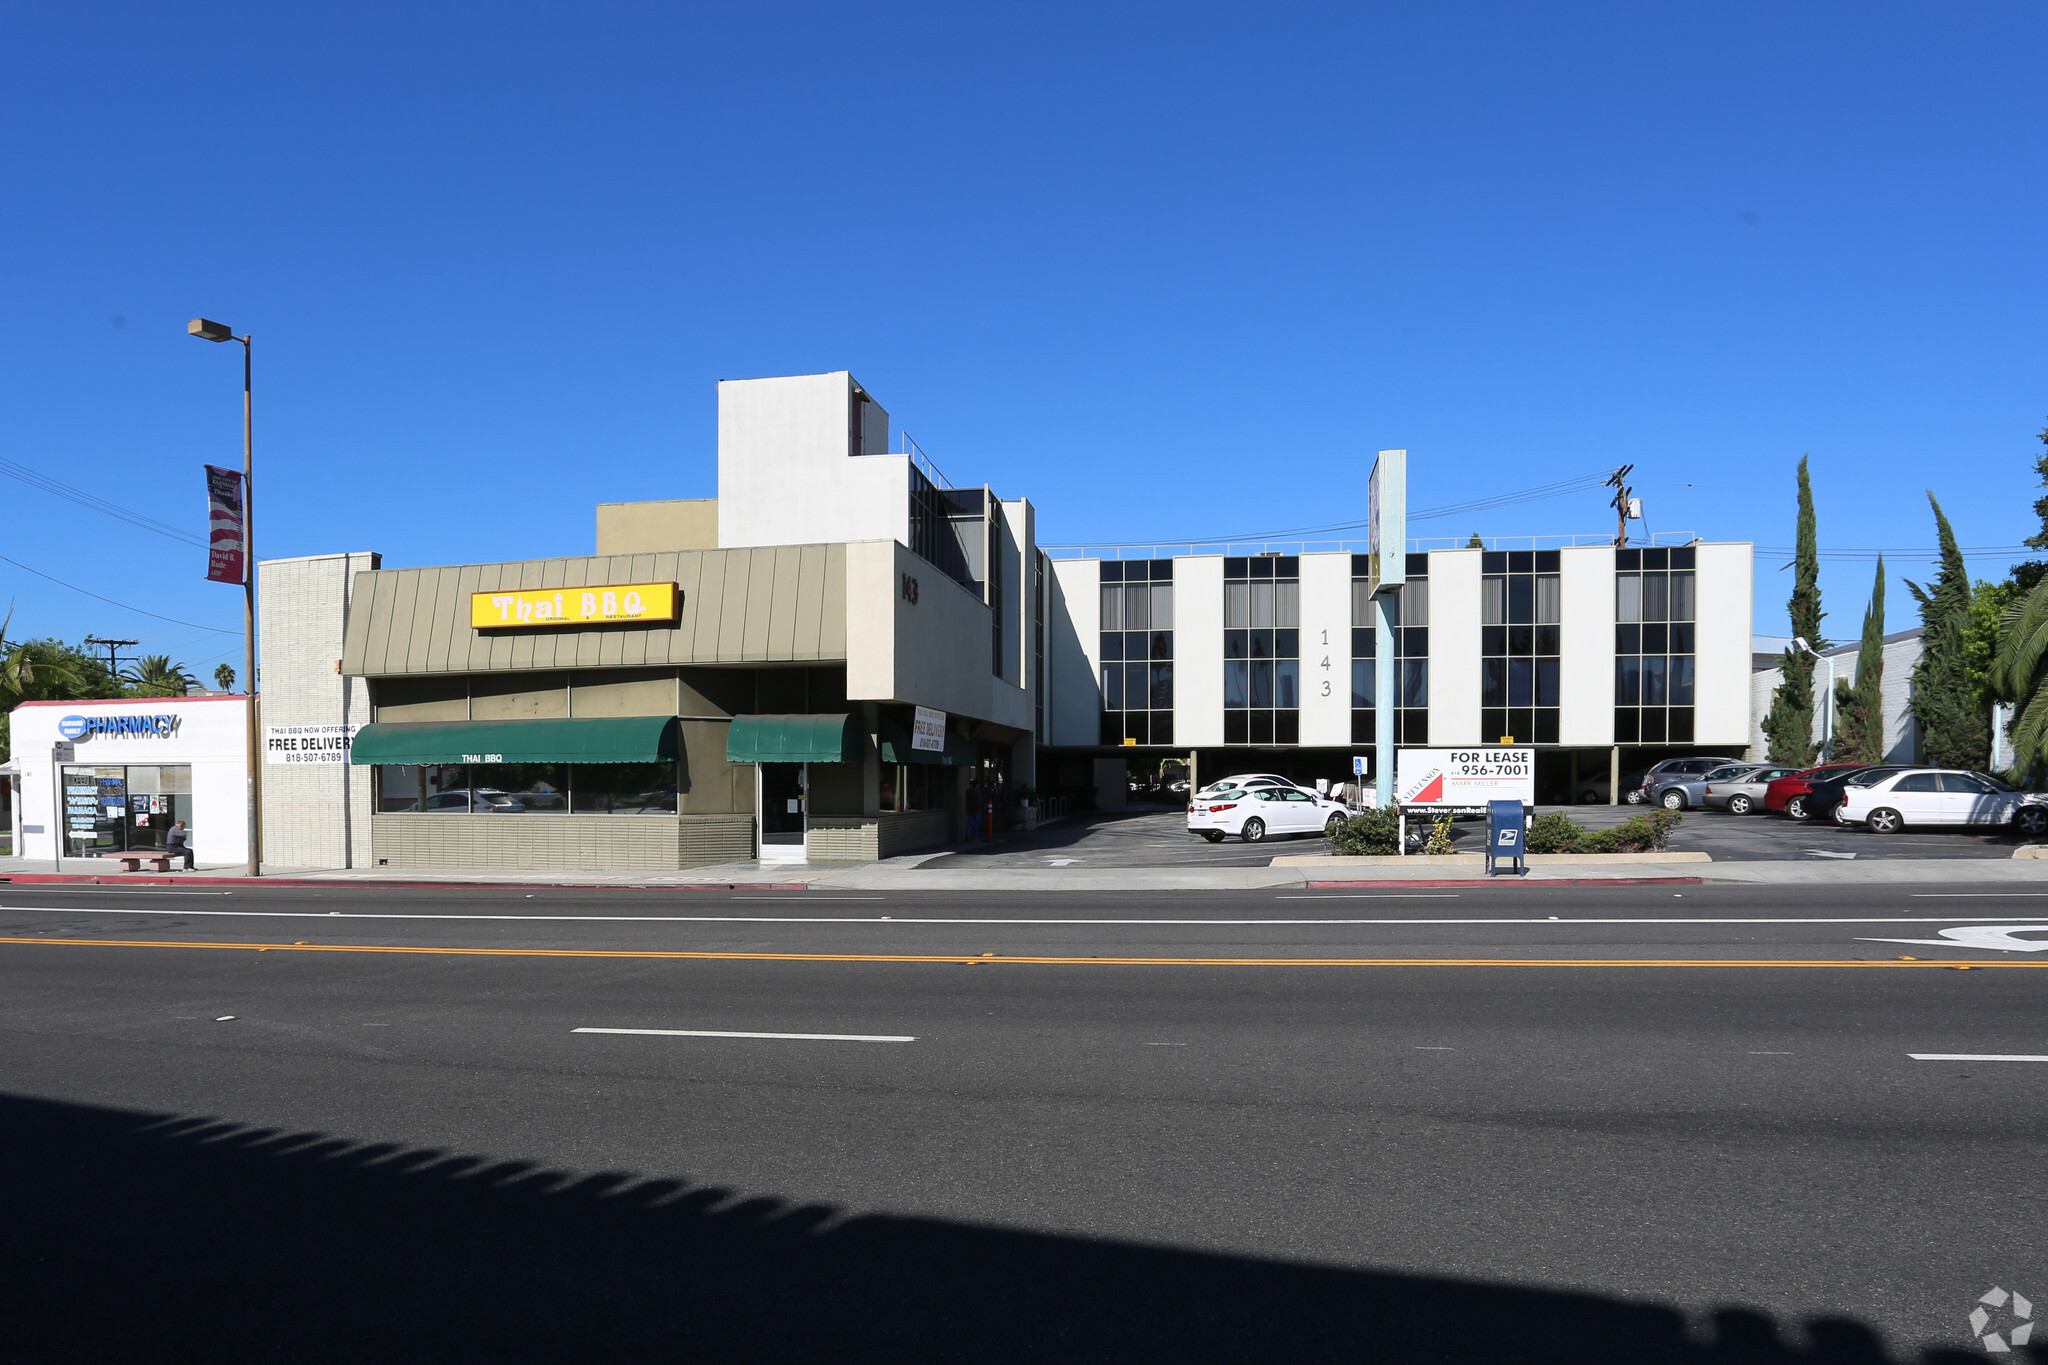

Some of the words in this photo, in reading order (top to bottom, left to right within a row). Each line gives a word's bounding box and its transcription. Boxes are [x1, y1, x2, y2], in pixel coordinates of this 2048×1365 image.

[214, 488, 233, 498] Thanks
[211, 550, 229, 561] David
[229, 553, 236, 562] B.
[211, 559, 226, 569] Rude
[902, 573, 919, 606] 143
[491, 592, 564, 622] Thai
[580, 591, 647, 617] BBQ
[86, 714, 175, 735] PHARMACY
[271, 727, 287, 735] THAI
[321, 725, 356, 734] OFFERING
[269, 738, 298, 751] FREE
[286, 752, 342, 763] 818-507-6789
[461, 754, 481, 763] THAI
[485, 754, 503, 763] BBQ
[1451, 752, 1480, 763] FOR
[1485, 752, 1529, 763] LEASE
[1462, 765, 1528, 776] 956-7001
[1404, 767, 1440, 800] STEVENSON
